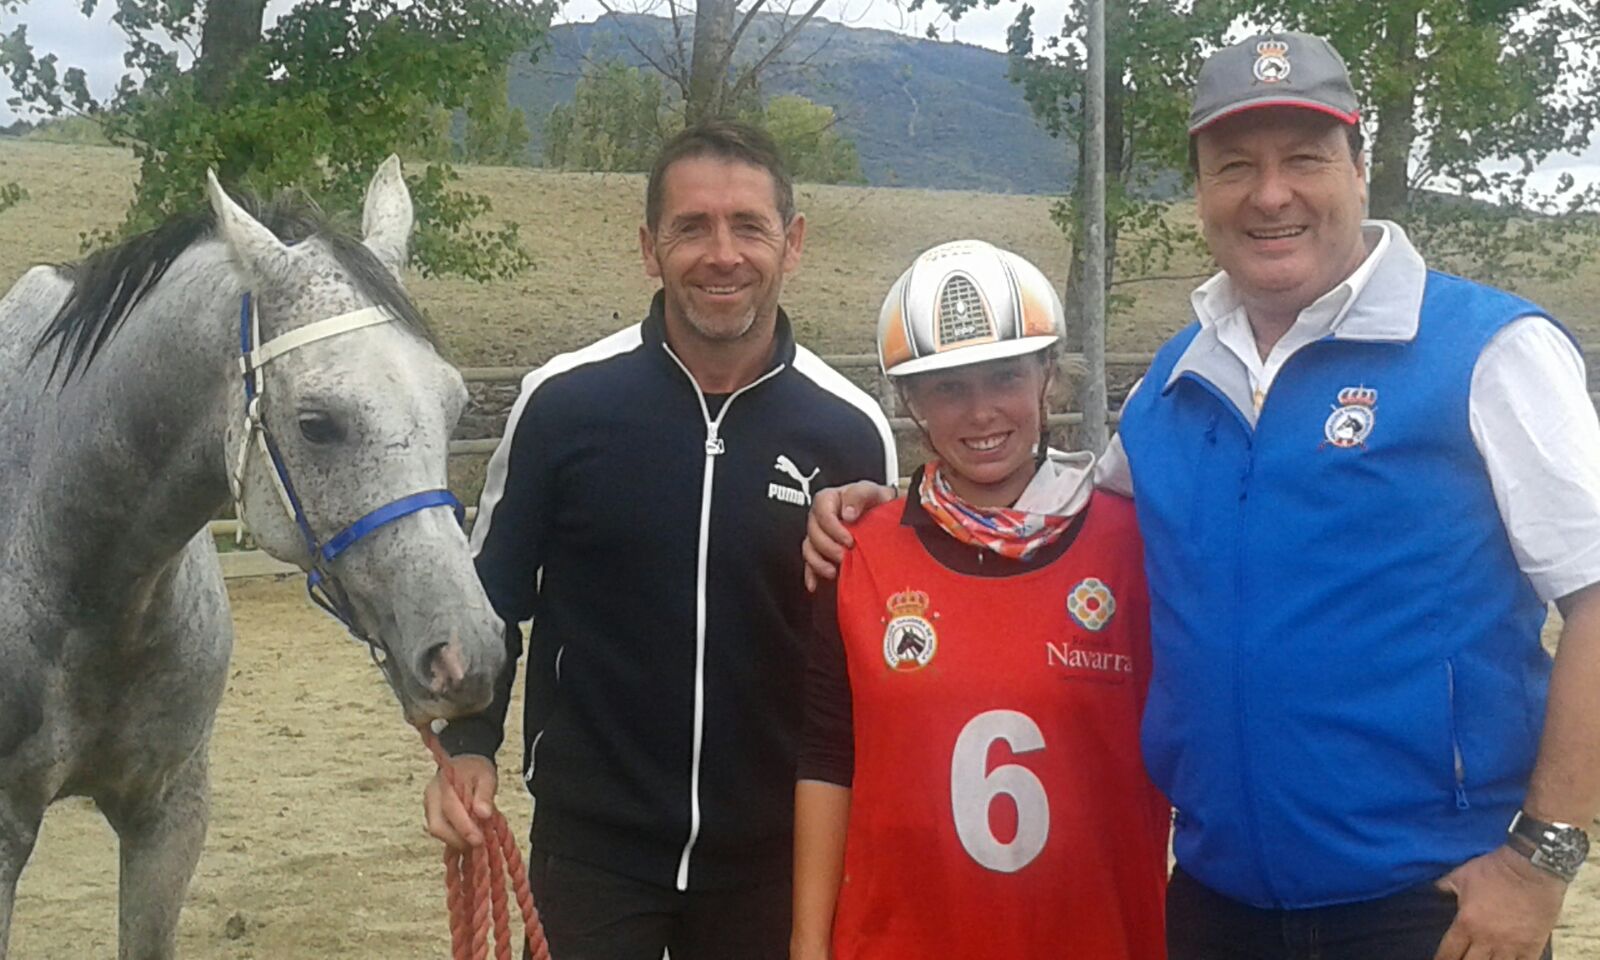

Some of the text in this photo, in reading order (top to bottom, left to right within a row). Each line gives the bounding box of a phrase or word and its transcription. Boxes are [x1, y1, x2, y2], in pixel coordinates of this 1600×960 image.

[768, 483, 805, 506] PUMA
[1046, 641, 1133, 672] Navarra
[951, 709, 1050, 872] 6
